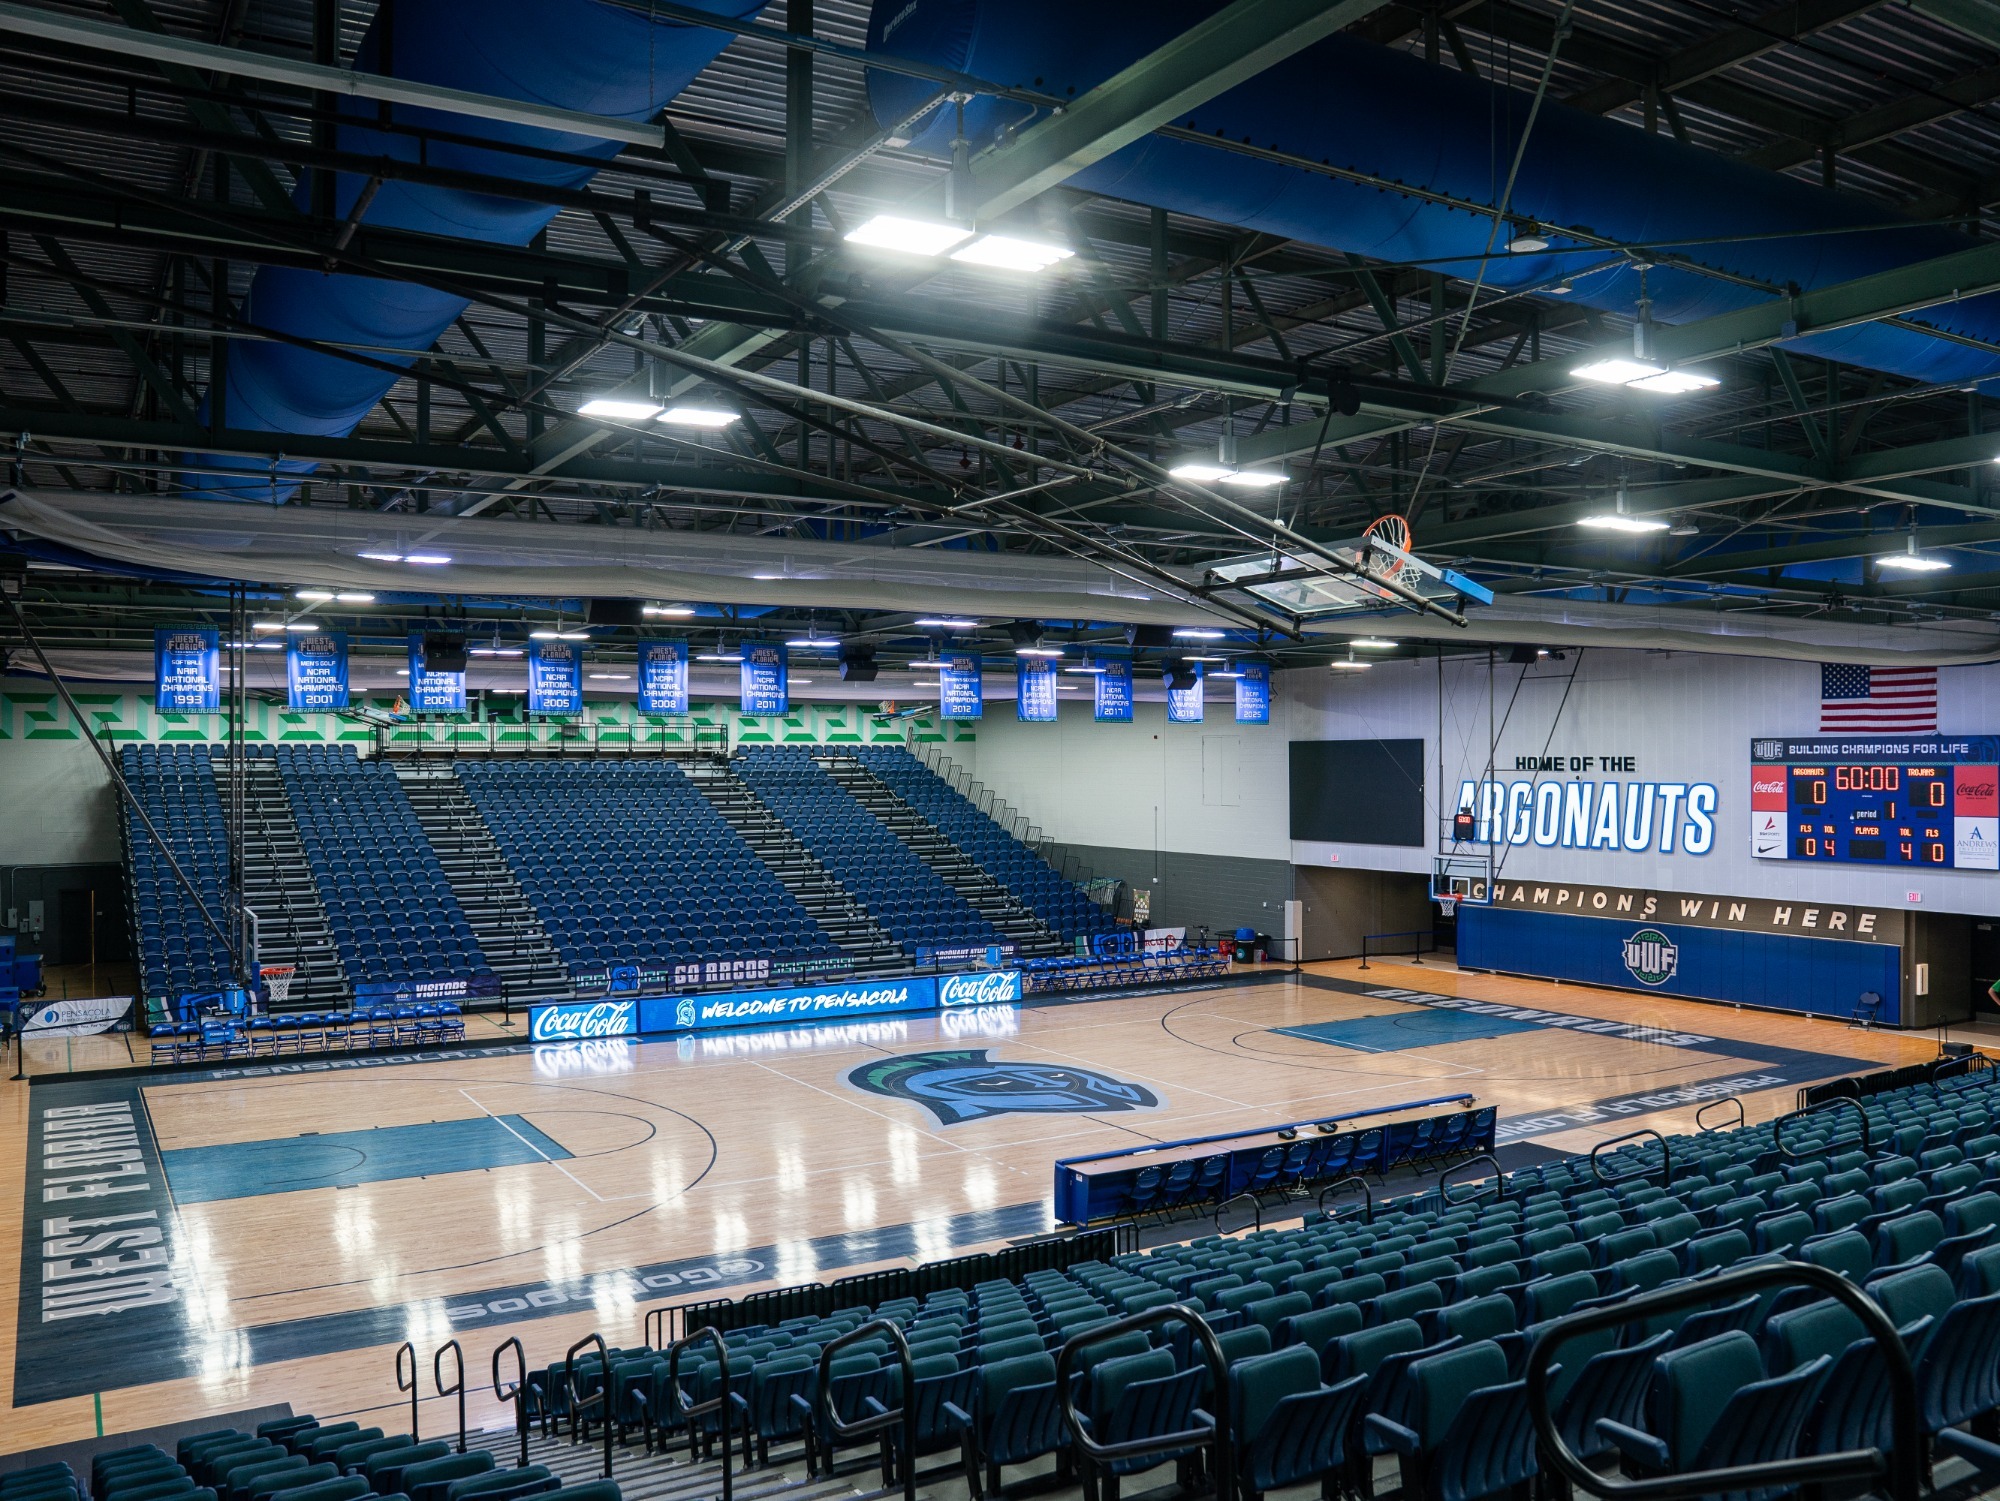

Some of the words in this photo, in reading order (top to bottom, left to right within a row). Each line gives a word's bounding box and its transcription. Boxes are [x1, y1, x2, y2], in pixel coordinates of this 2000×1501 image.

[168, 641, 205, 650] FLORIDA
[175, 635, 199, 643] WEST
[307, 637, 329, 645] WEST
[300, 643, 336, 652] FLORIDA
[541, 649, 573, 659] FLORIDA
[649, 652, 678, 661] FLORIDA
[164, 676, 209, 684] NATIONAL
[174, 695, 202, 704] 1993
[306, 695, 332, 704] 2001
[424, 696, 452, 705] 2004
[543, 699, 569, 707] 2005
[652, 700, 676, 708] 2008
[1756, 742, 1783, 758] UWF
[1789, 744, 1838, 754] BUILDING
[1841, 744, 1909, 754] CHAMPIONS
[1913, 744, 1937, 753] FOR
[1940, 744, 1969, 754] LIFE
[1516, 756, 1564, 771] HOME
[1570, 757, 1593, 771] OF
[1599, 756, 1635, 772] THE
[1793, 768, 1824, 776] ARGONAUTS
[1836, 766, 1899, 790] 60:00
[1753, 780, 1784, 793] Coca-Cola
[1813, 781, 1826, 804] 0
[1956, 782, 1996, 797] Coca-Cola
[1930, 782, 1944, 806] 0
[1856, 810, 1876, 819] period
[1890, 802, 1895, 818] 1
[1452, 781, 1718, 854] ARGONAUTS
[1800, 825, 1812, 833] FLS
[1855, 827, 1879, 835] PLAYER
[1900, 828, 1911, 836] TOL
[1926, 829, 1939, 837] FLS
[1806, 839, 1816, 855] 0
[1825, 840, 1835, 855] 4
[1957, 840, 1997, 848] ANDREWS
[1901, 843, 1912, 860] 4
[1932, 844, 1943, 861] 0
[1909, 893, 1919, 901] EXIT
[1472, 883, 1658, 915] CHAMPIONS
[1680, 900, 1746, 922] WIN
[1772, 906, 1876, 934] HERE
[1145, 938, 1164, 946] RCLE
[1627, 944, 1677, 975] UWF
[674, 965, 699, 984] GO
[706, 959, 769, 983] ARGOS
[416, 981, 467, 998] VISITORS
[941, 971, 1018, 1006] Coca-Cola
[702, 996, 788, 1018] WELCOME
[788, 996, 810, 1012] TO
[813, 988, 908, 1010] PENSACOLA
[62, 1008, 110, 1017] PENSACOLA
[1363, 988, 1715, 1046] ARGONAUTS
[533, 1001, 634, 1040] Coca-Cola
[212, 1051, 477, 1079] PENSACOLA,
[43, 1100, 150, 1202] FLORIDA
[42, 1210, 177, 1323] WEST
